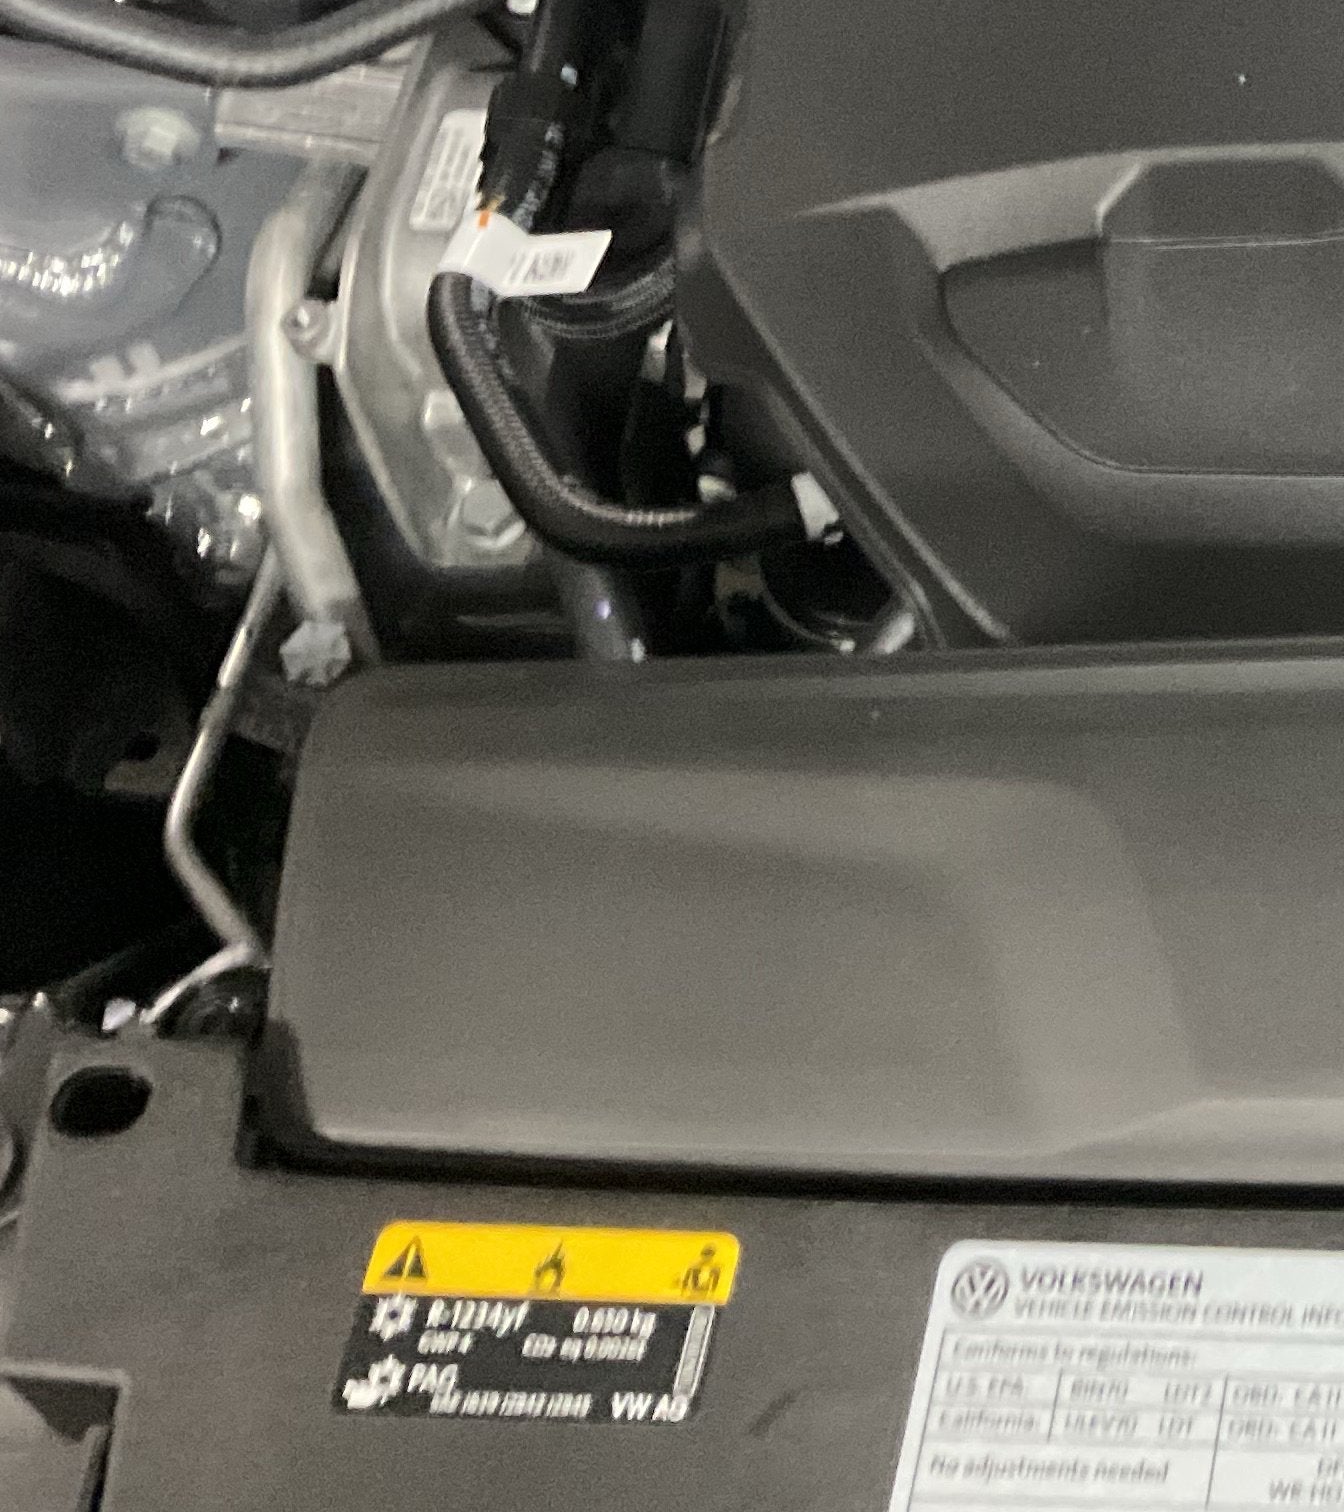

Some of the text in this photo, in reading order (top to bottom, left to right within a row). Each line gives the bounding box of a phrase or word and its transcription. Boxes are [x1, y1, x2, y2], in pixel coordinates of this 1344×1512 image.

[1021, 1269, 1203, 1298] VOLKSWAGEN
[1014, 1298, 1094, 1322] VEHICLE
[1100, 1300, 1197, 1325] EMISSION
[1203, 1303, 1294, 1328] CONTROL
[952, 1339, 1048, 1360] Conforms
[611, 1392, 653, 1420] VW
[930, 1454, 1170, 1483] No adjustments needed
